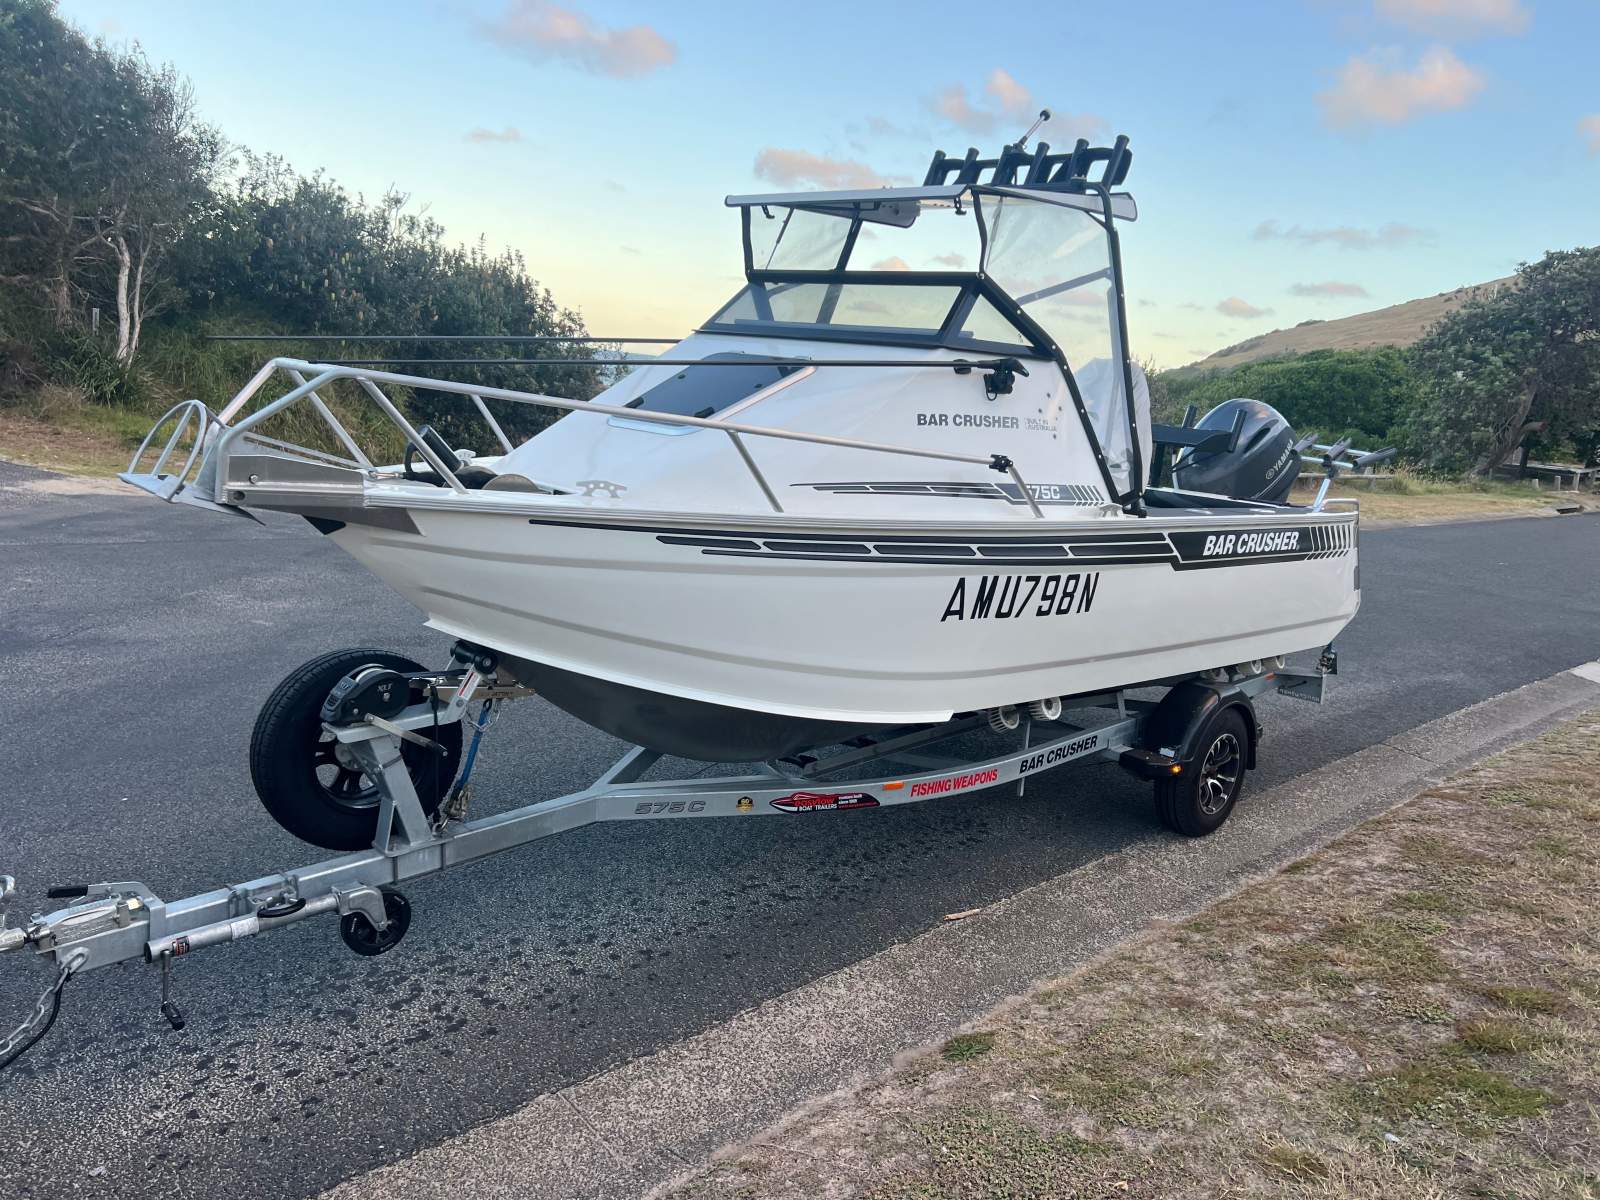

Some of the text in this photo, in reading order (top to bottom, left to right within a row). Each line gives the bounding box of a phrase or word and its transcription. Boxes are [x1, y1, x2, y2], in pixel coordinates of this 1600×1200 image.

[917, 413, 1019, 429] BAR CRUSHER
[1273, 437, 1294, 471] YAMAHA
[1203, 531, 1300, 556] BAR CRUSHER
[940, 572, 1100, 622] AMU798N
[1019, 735, 1098, 774] BAR CRUSHER
[910, 769, 998, 797] FISHING WEAPONS
[634, 800, 707, 815] 575C
[798, 804, 813, 812] BOAT
[815, 803, 838, 811] TRAILERS
